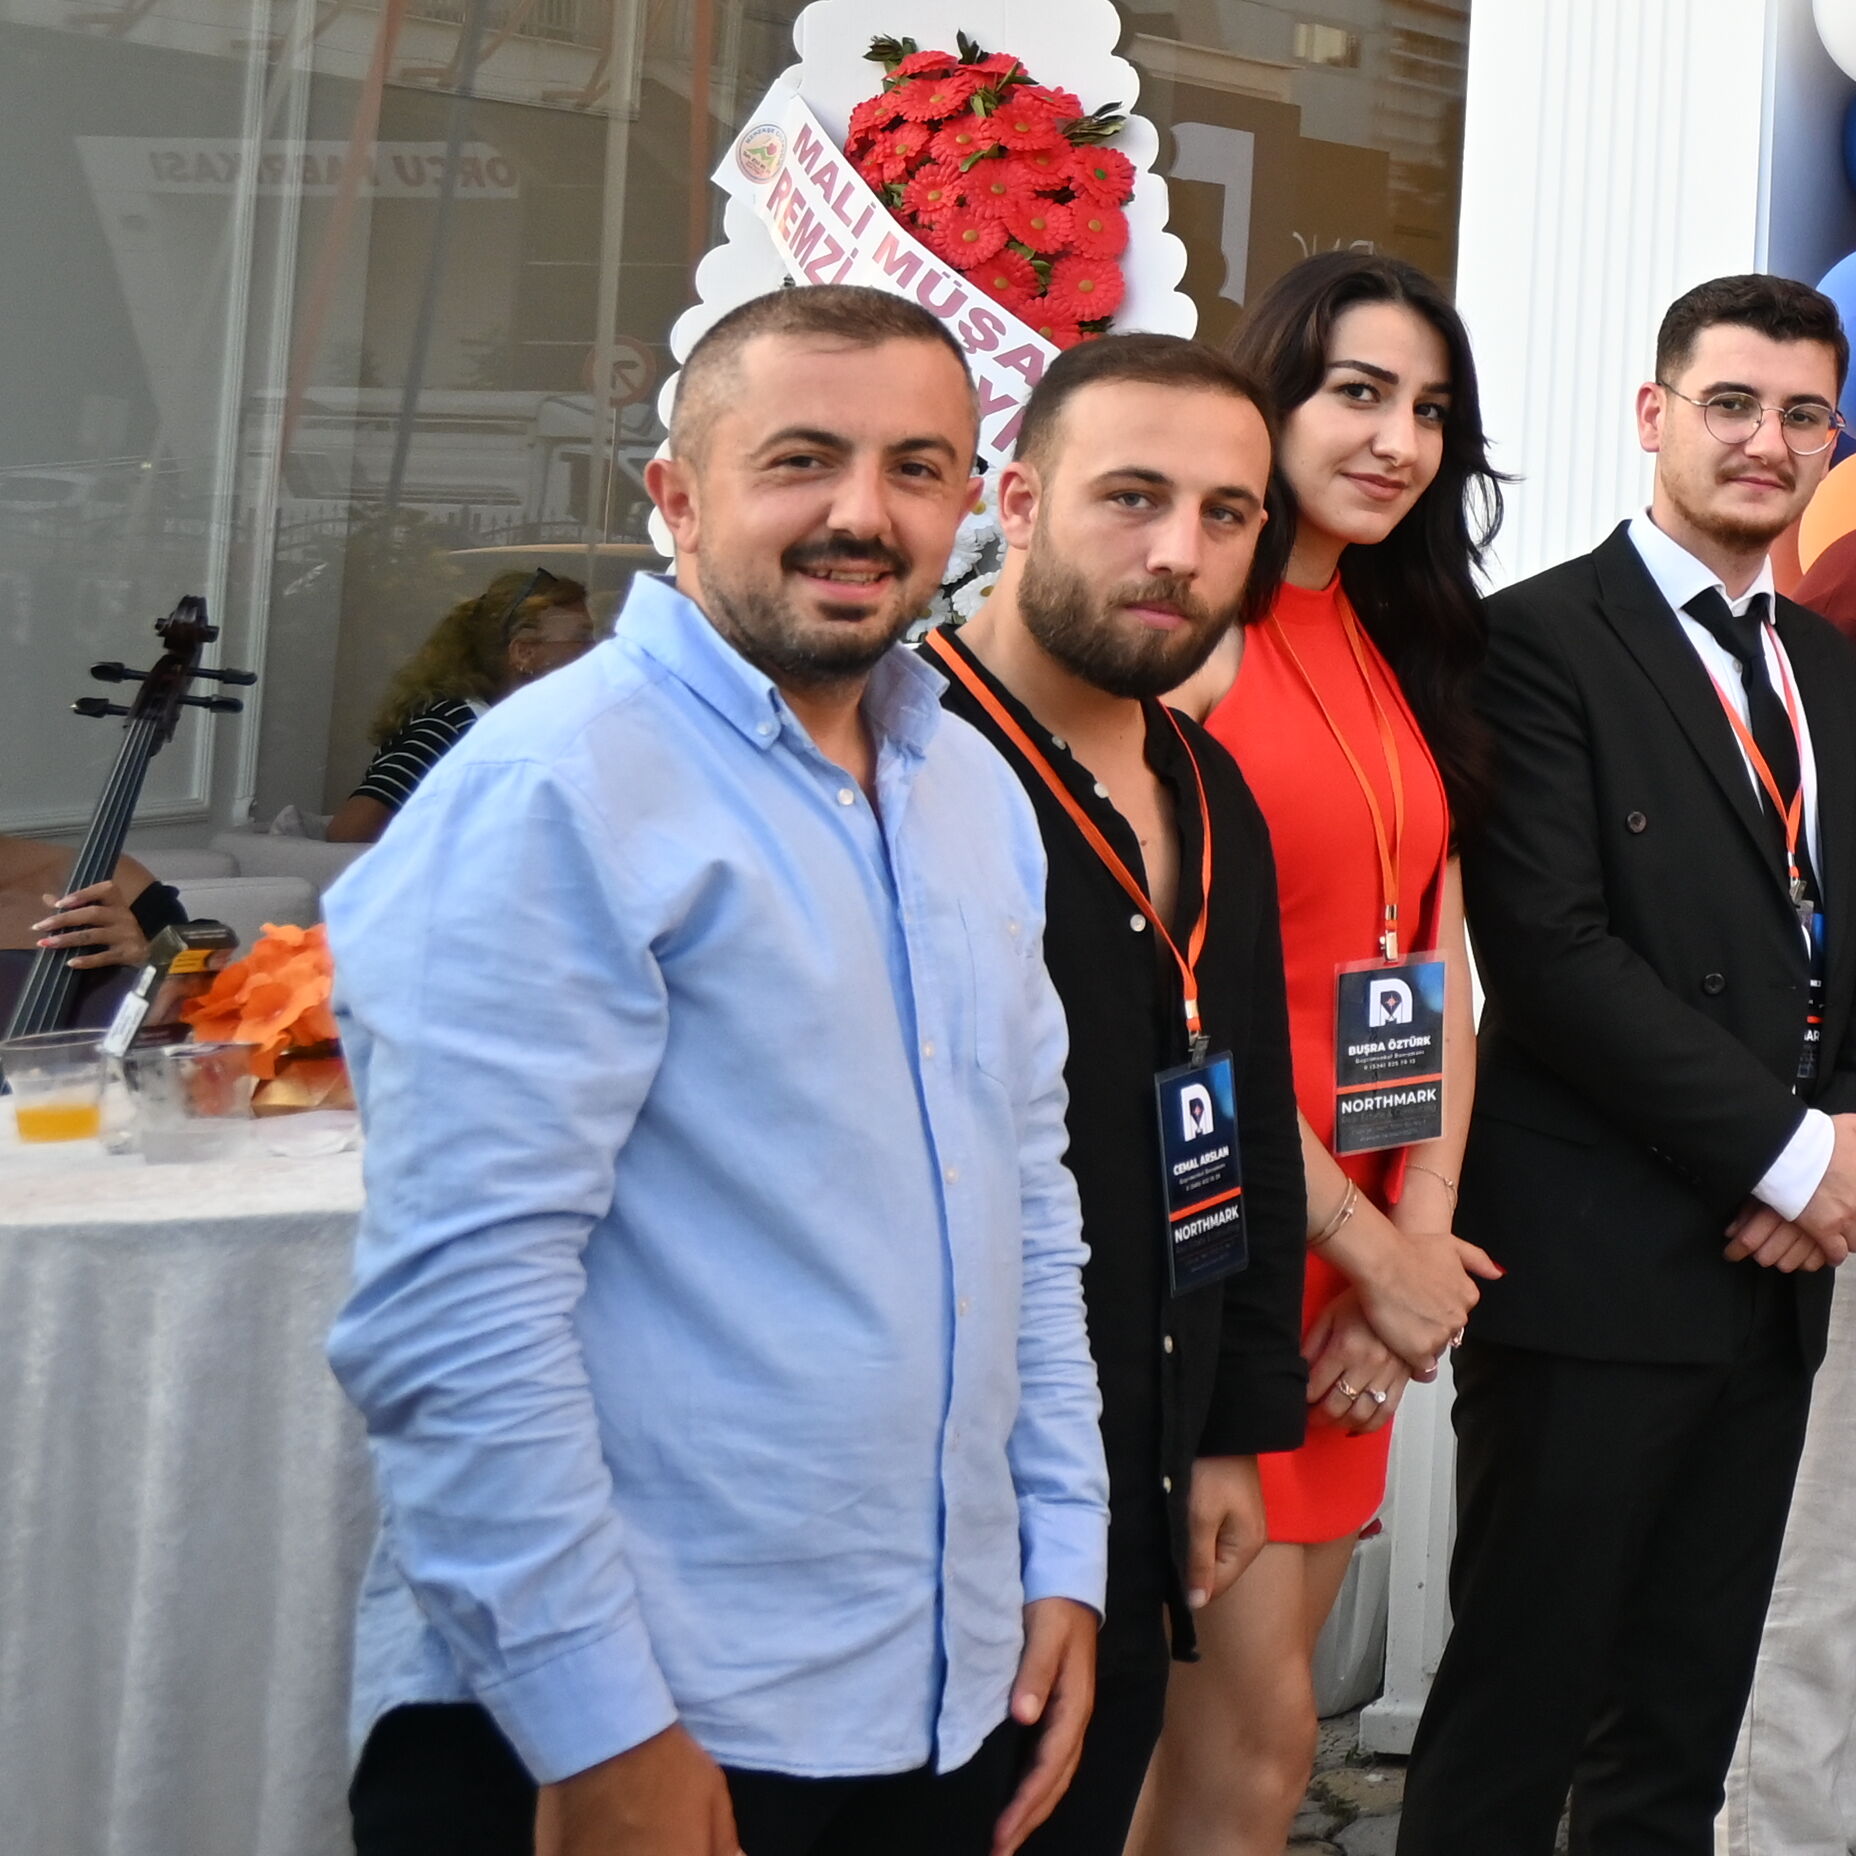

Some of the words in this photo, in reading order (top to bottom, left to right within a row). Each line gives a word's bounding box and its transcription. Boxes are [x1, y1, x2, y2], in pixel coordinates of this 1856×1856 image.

[793, 123, 878, 240] MALİ
[872, 231, 1046, 390] MÜŞA
[1388, 1035, 1432, 1050] ÖZTÜRK
[1341, 1088, 1438, 1115] NORTHMARK
[1174, 1205, 1240, 1244] NORTHMARK
